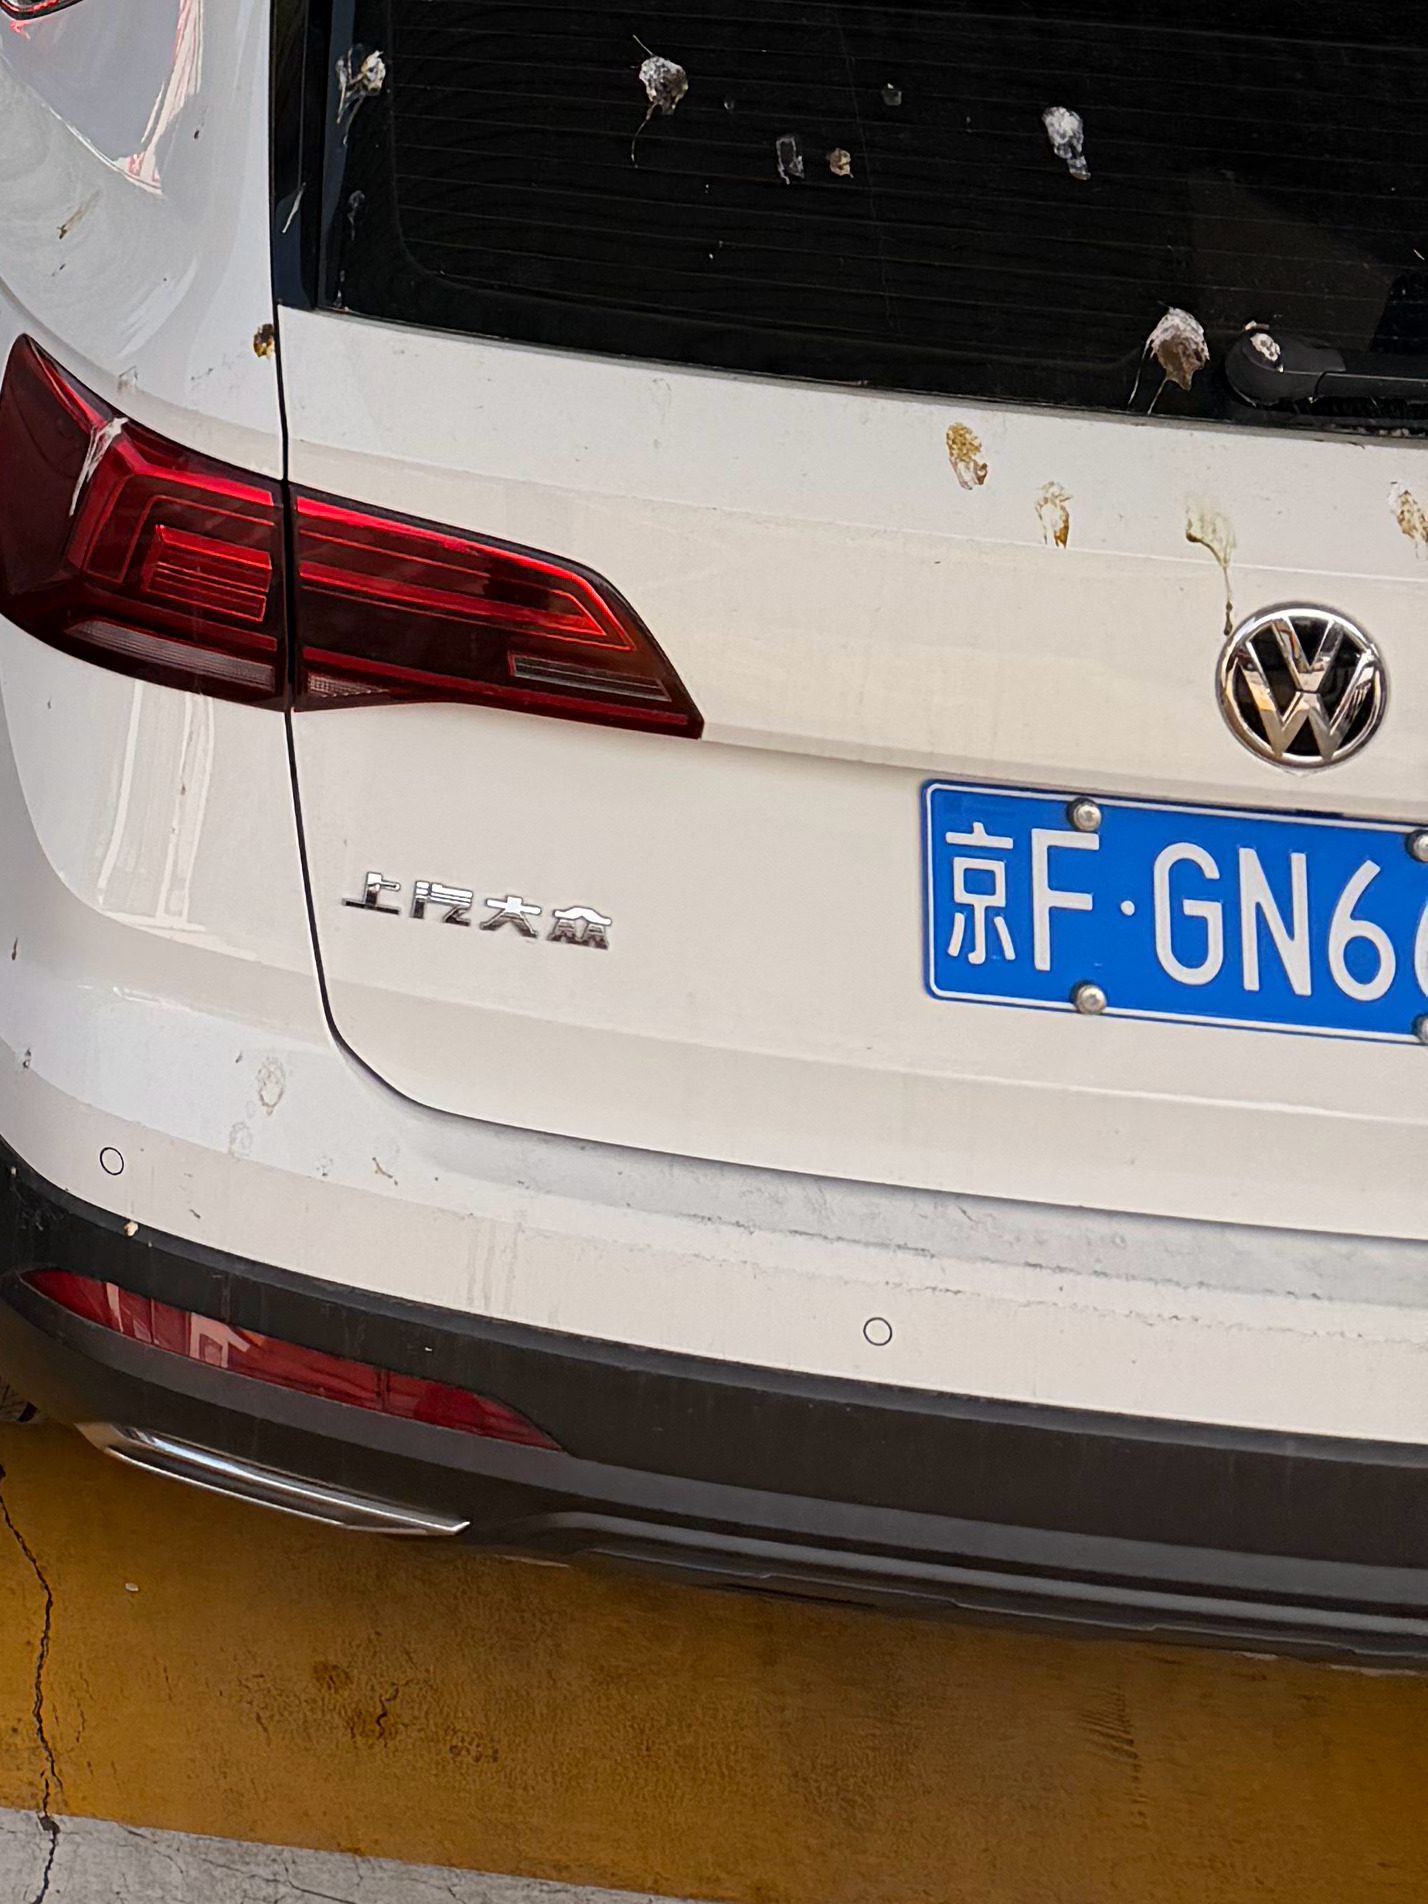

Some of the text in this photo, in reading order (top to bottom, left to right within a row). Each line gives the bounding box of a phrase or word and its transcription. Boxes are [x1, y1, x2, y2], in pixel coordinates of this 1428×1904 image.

[343, 870, 612, 951] 上汽大众
[944, 820, 1428, 1004] 京F·GN6
